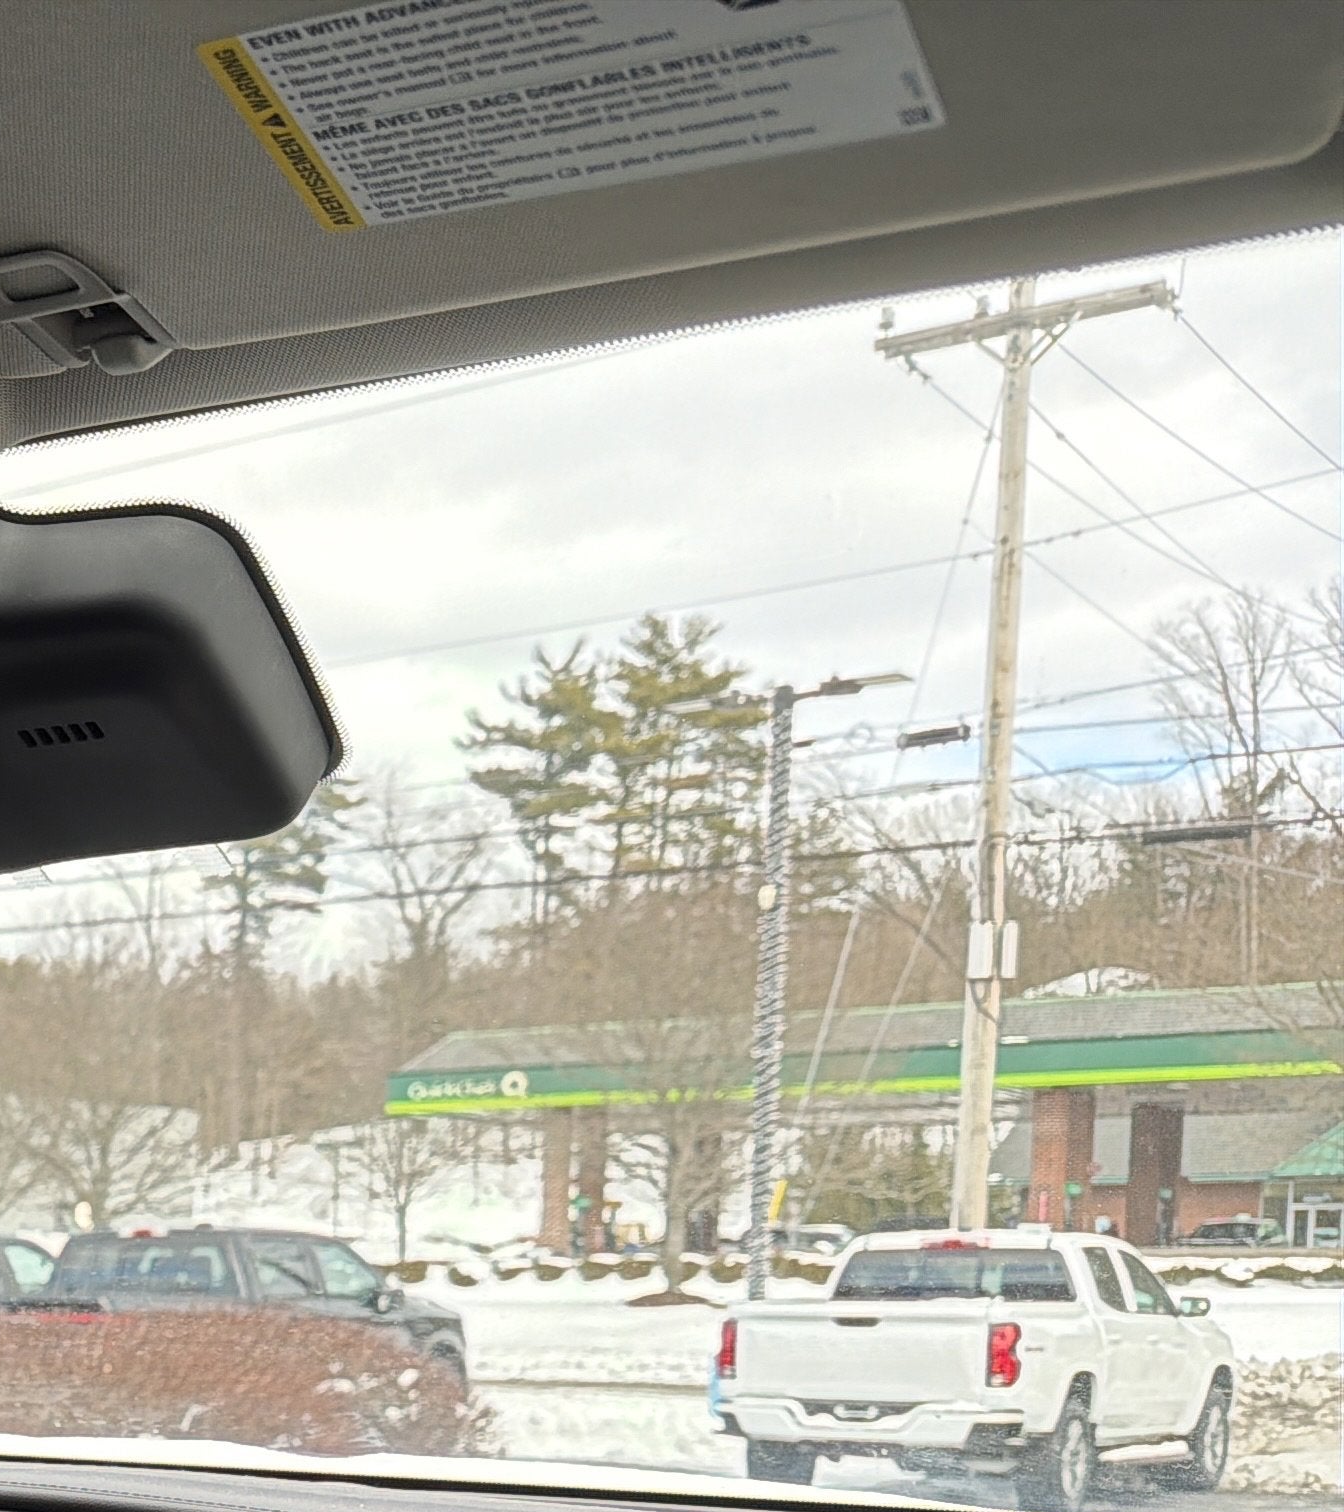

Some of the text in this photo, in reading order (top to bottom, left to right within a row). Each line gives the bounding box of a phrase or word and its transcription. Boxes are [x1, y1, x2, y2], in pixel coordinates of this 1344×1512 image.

[246, 28, 303, 49] EVEN
[301, 15, 361, 37] WITH
[212, 46, 273, 114] WARNING
[310, 119, 371, 141] MÊME
[369, 108, 423, 130] AVEC
[422, 99, 466, 119] DES
[464, 88, 522, 111] SACS
[269, 130, 354, 227] AVERTISSEMENT
